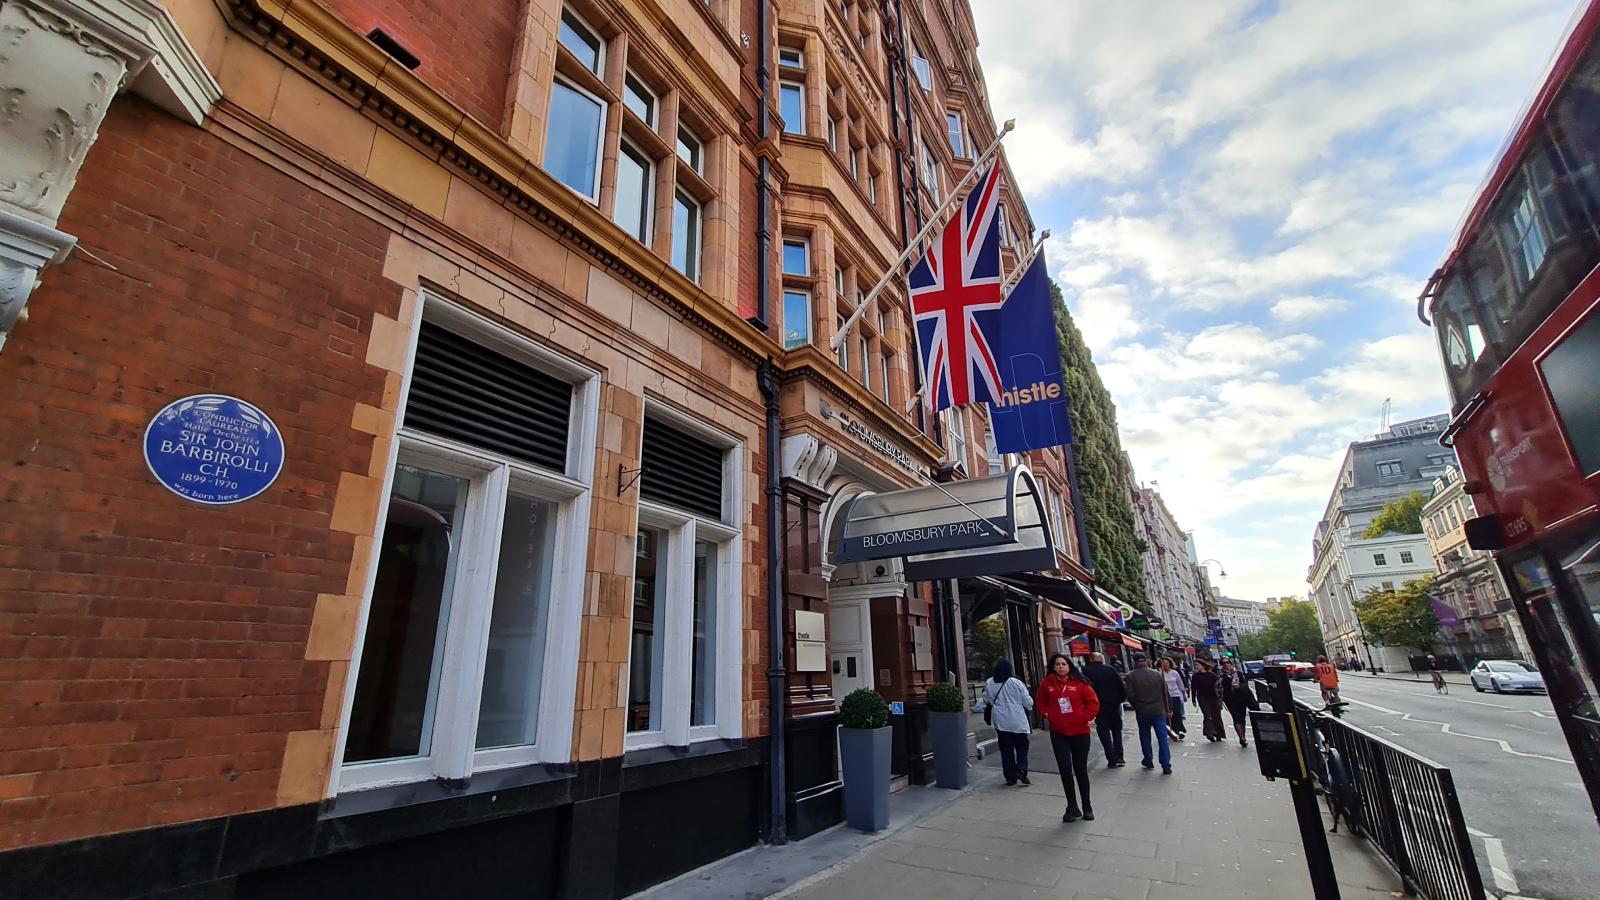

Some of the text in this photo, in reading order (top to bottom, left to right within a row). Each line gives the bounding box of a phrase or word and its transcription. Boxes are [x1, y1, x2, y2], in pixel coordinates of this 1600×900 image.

[996, 381, 1061, 407] histle
[194, 410, 258, 430] CONDUCTOR
[199, 418, 250, 435] LAUREATE
[180, 430, 260, 457] SIR JOHN
[160, 440, 269, 473] BARBIROLLI
[200, 463, 230, 479] C.H.
[174, 483, 189, 494] was
[191, 490, 214, 500] born
[863, 520, 985, 548] BLOOMSBURY PARK
